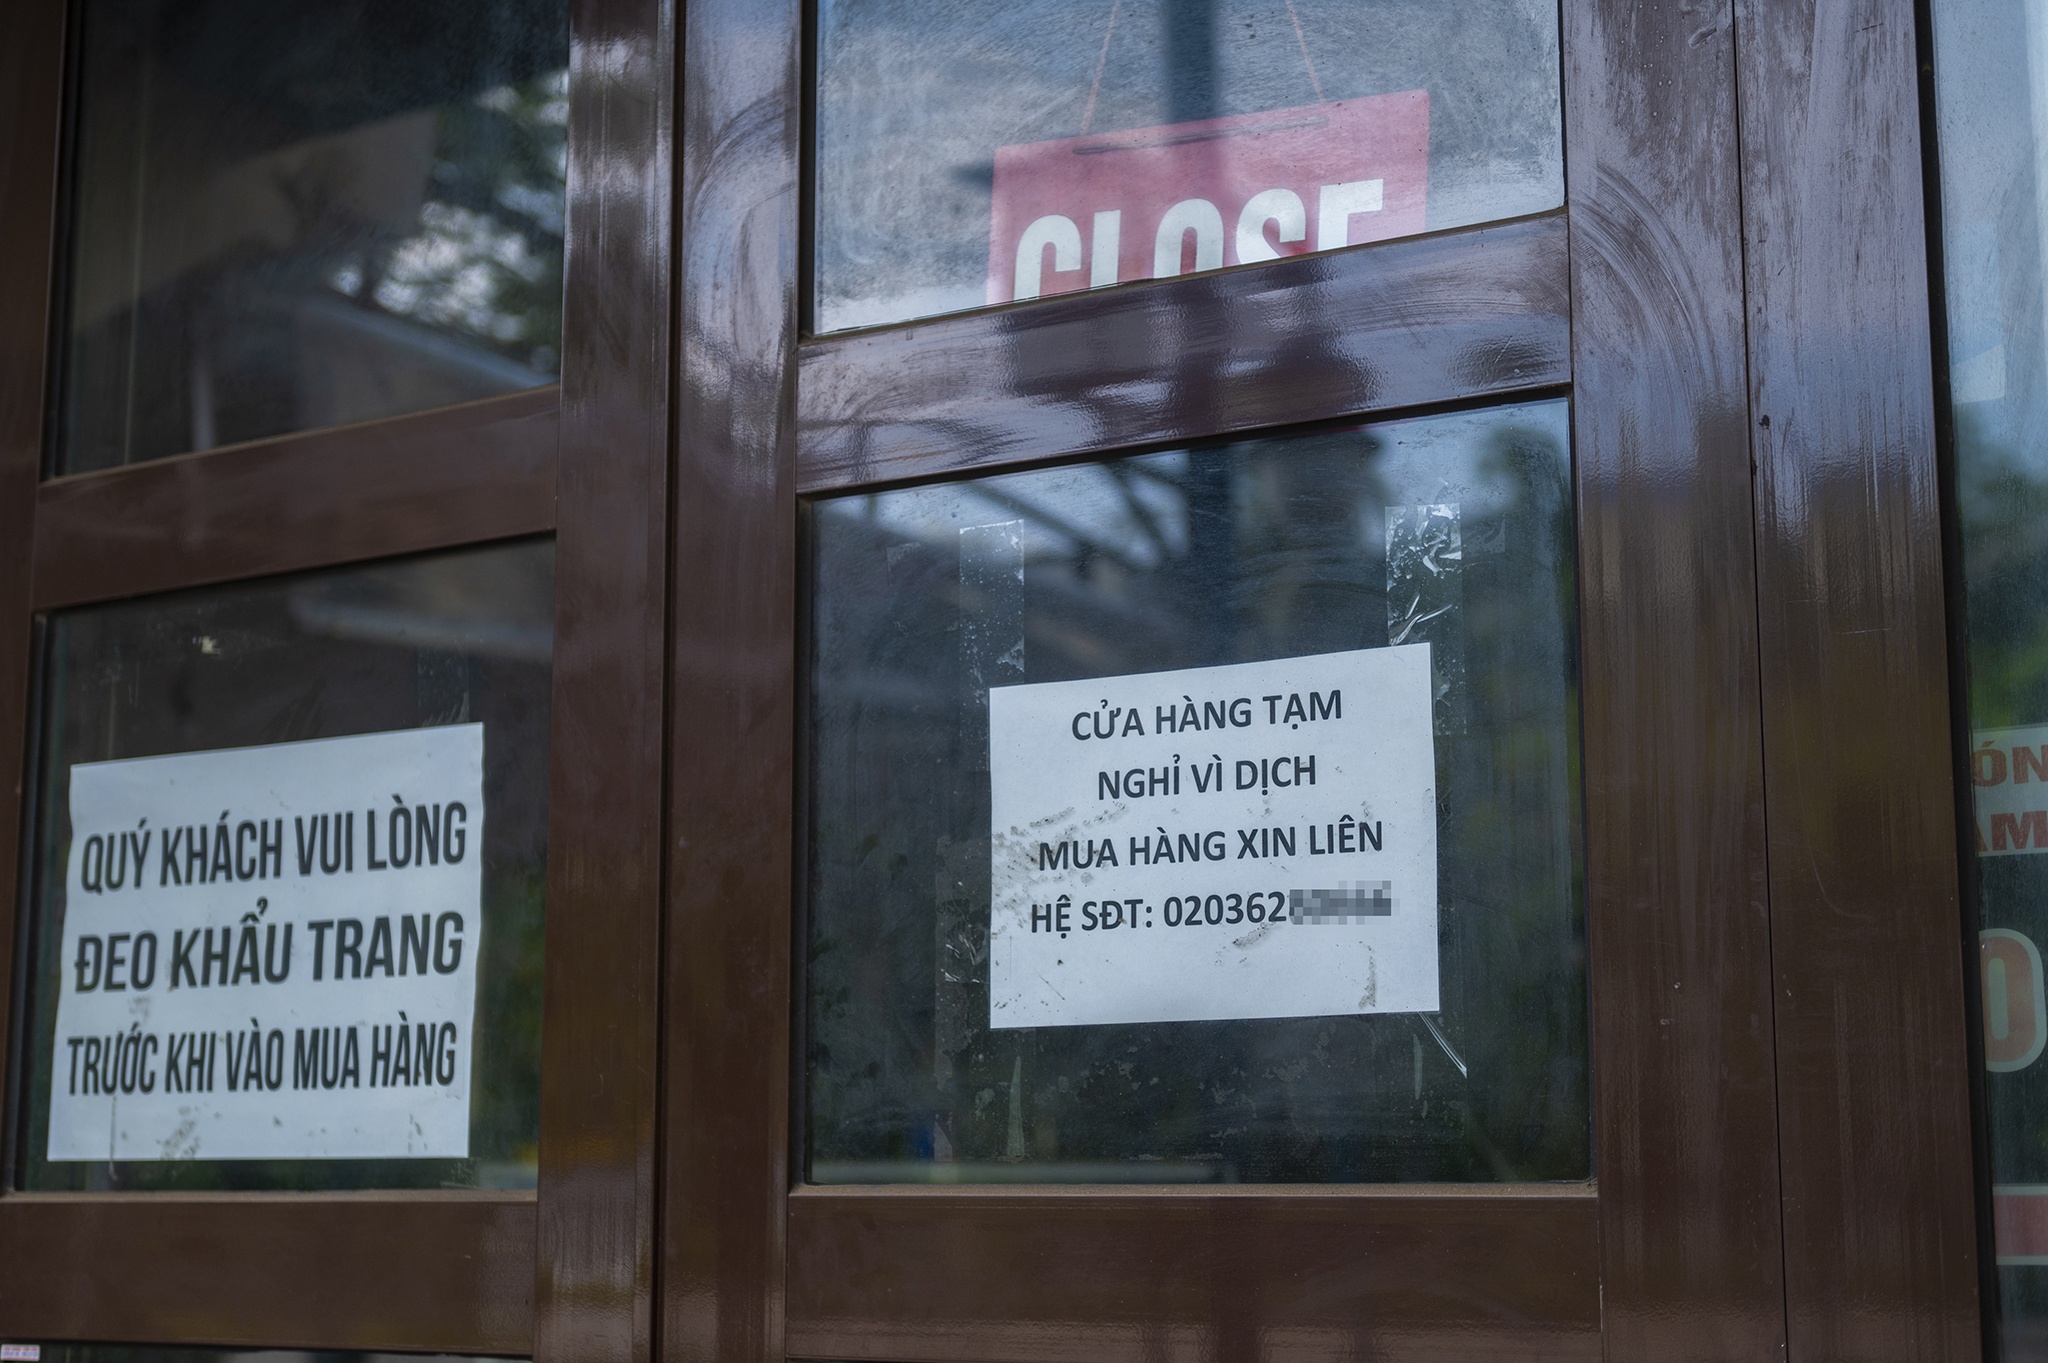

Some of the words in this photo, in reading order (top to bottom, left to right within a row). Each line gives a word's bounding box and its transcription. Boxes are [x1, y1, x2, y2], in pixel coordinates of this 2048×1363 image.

[1072, 698, 1145, 741] CỬA
[1156, 695, 1252, 735] HÀNG
[1262, 689, 1342, 730] TẠM
[1098, 753, 1181, 801] NGHỈ
[1190, 754, 1223, 794] VÌ
[1235, 754, 1316, 796] DỊCH
[81, 817, 152, 895] QUÝ
[159, 810, 283, 887] KHÁCH
[294, 811, 354, 876] VUI
[367, 794, 467, 871] LÒNG
[1039, 838, 1119, 872] MUA
[1130, 826, 1226, 866] HÀNG
[1237, 826, 1296, 860] XIN
[1309, 814, 1383, 855] LIÊN
[74, 931, 158, 993] ĐEO
[170, 897, 294, 989] KHẨU
[307, 911, 464, 981] TRANG
[1031, 894, 1072, 939] HỆ
[1081, 898, 1152, 932] SĐT:
[67, 1022, 159, 1096] TRƯỚC
[164, 1032, 217, 1093] KHI
[225, 1017, 285, 1092] VÀO
[293, 1026, 360, 1090] MUA
[369, 1011, 457, 1088] HÀNG
